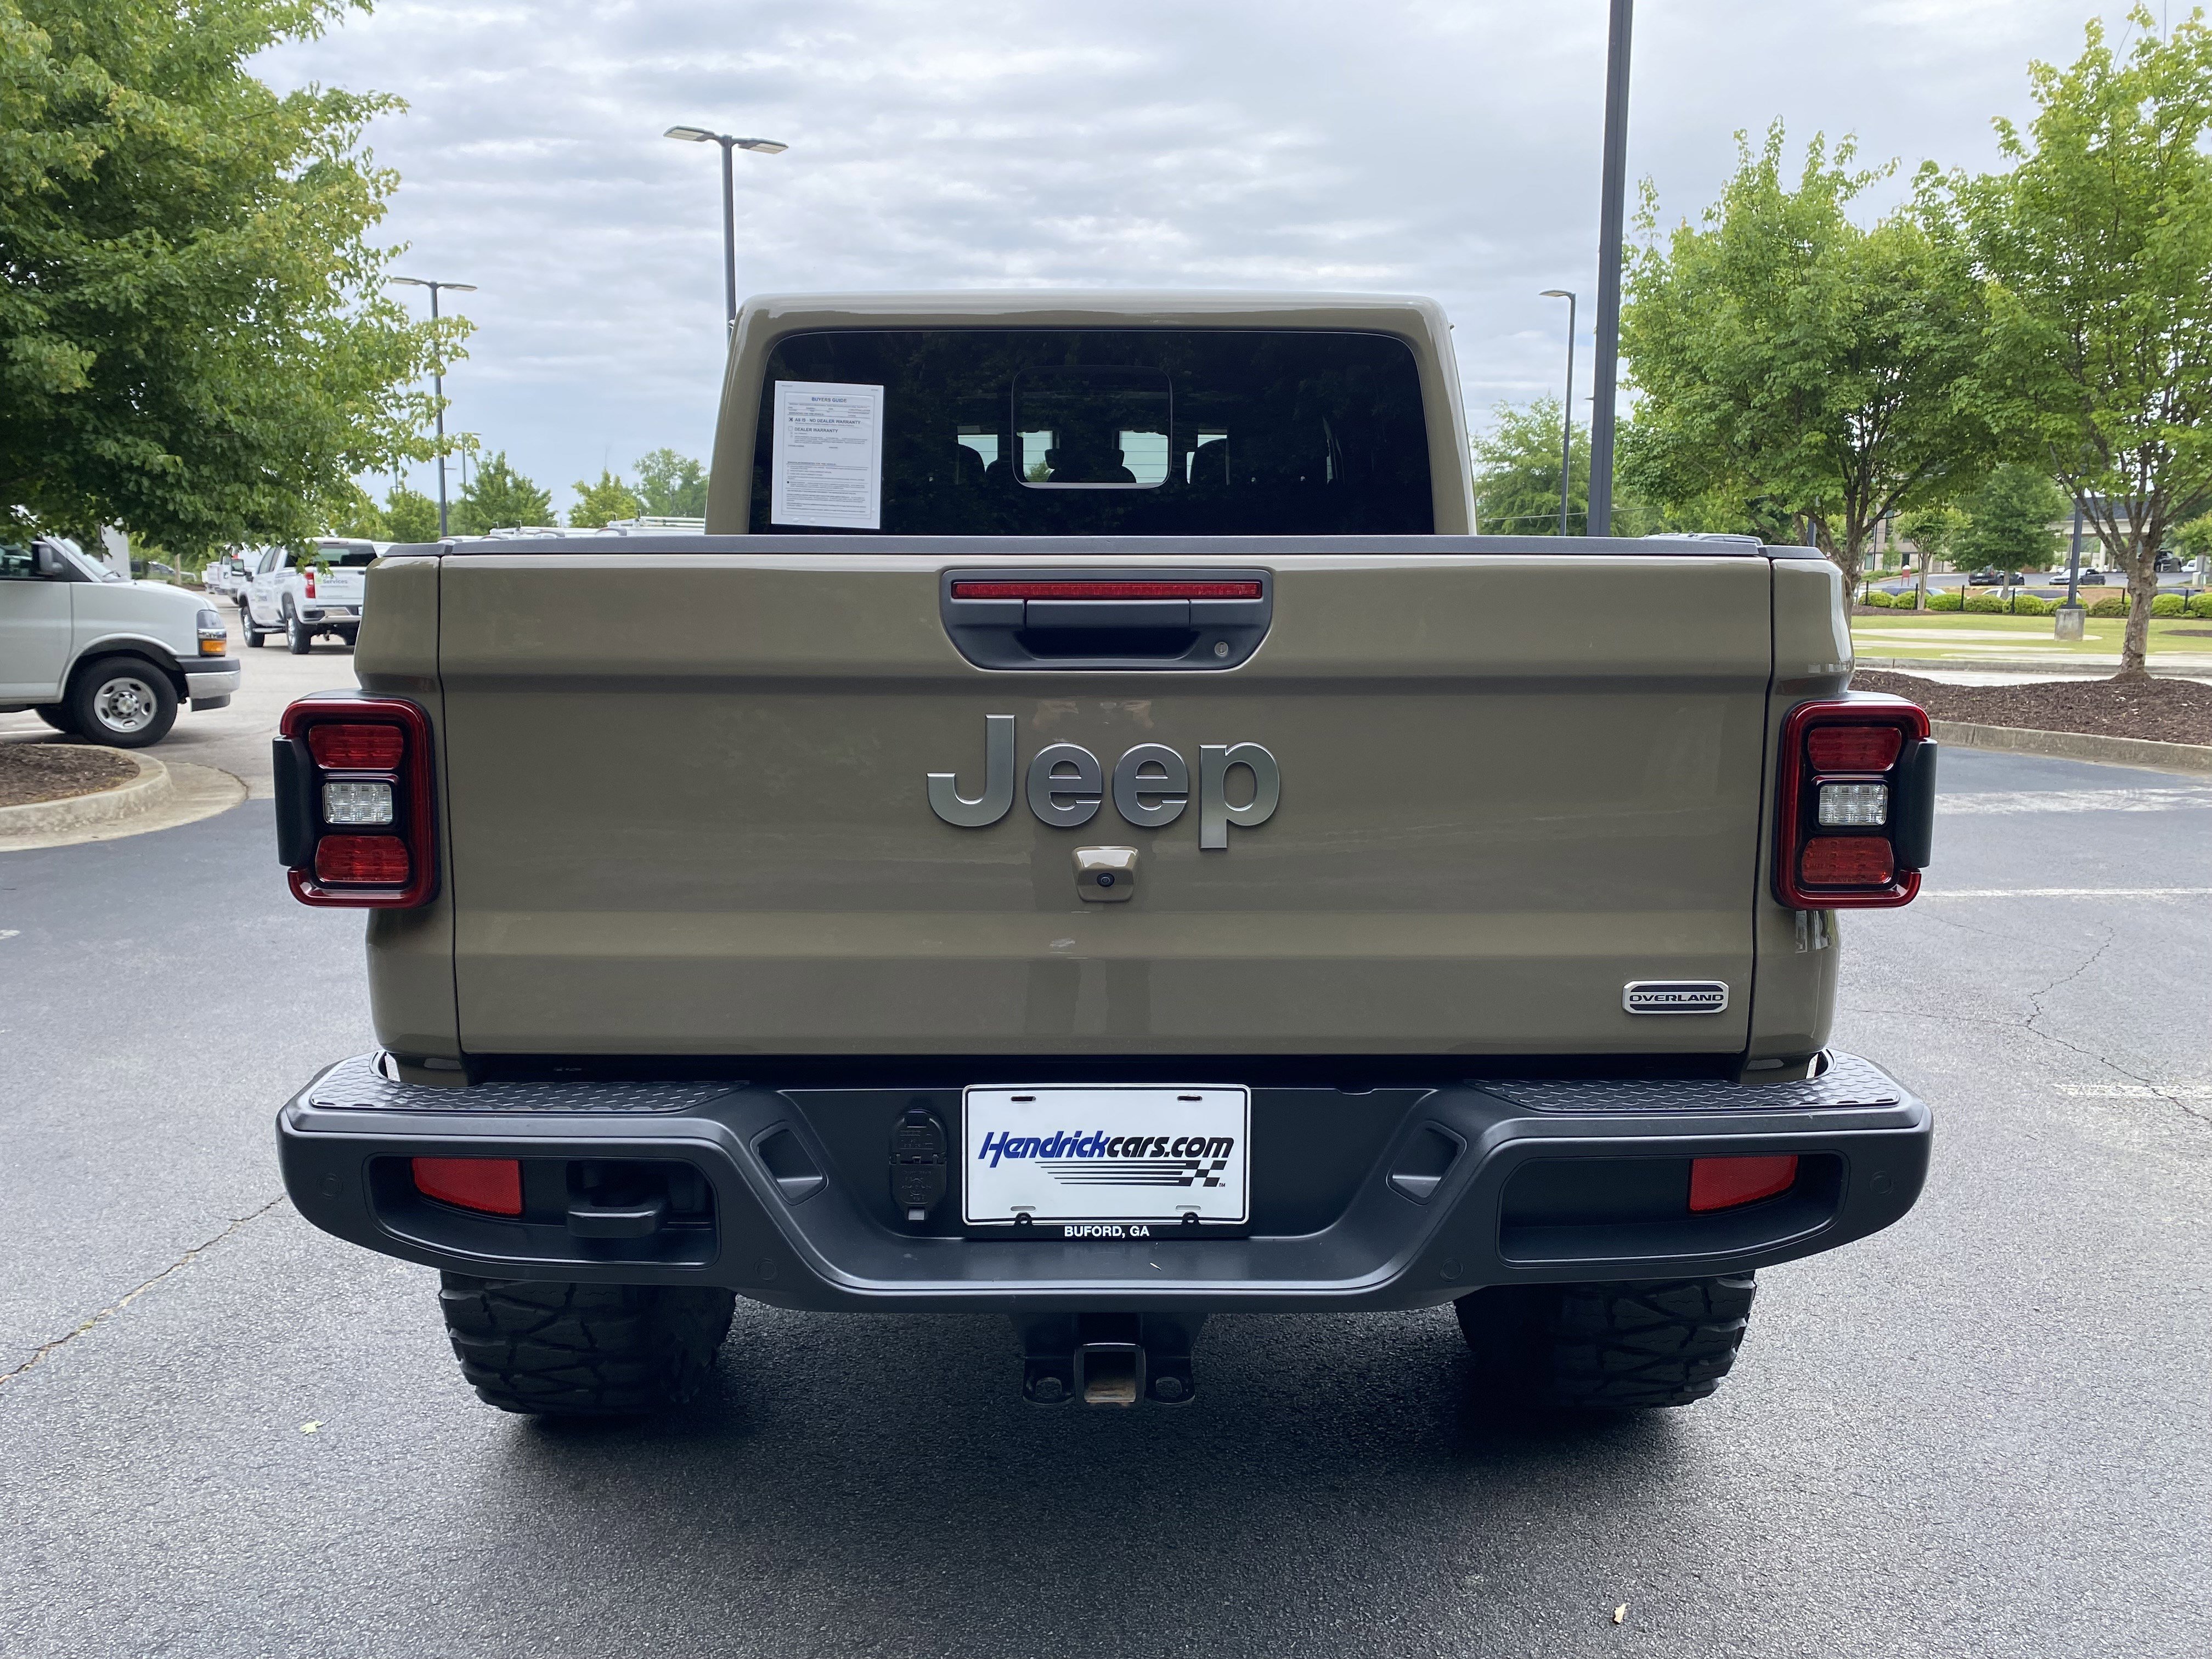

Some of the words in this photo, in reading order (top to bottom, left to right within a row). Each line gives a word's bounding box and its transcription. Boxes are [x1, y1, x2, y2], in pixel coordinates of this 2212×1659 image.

[926, 714, 1280, 849] Jeep
[978, 1130, 1234, 1168] Hendrickcars.com
[1064, 1226, 1126, 1238] BUFORD,
[1129, 1225, 1150, 1237] GA
